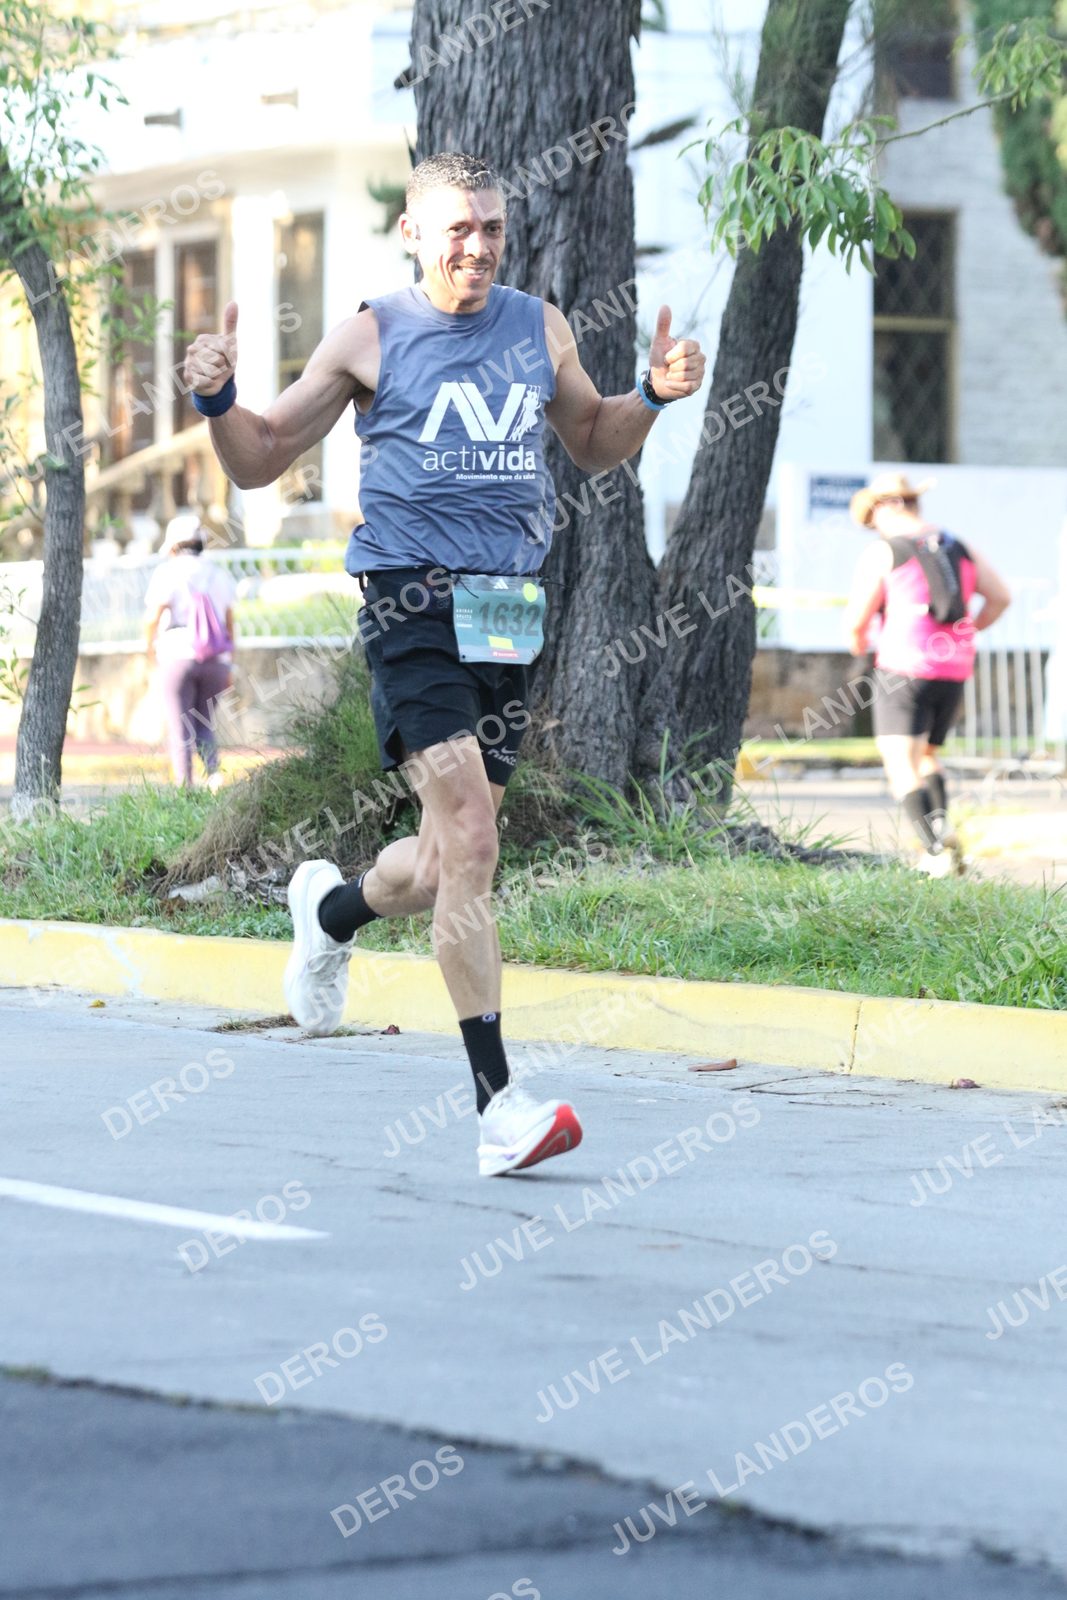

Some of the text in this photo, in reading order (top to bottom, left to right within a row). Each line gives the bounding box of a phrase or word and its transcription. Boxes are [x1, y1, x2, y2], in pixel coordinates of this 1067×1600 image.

[422, 445, 536, 471] activida
[500, 474, 514, 482] que
[479, 602, 540, 636] 1632
